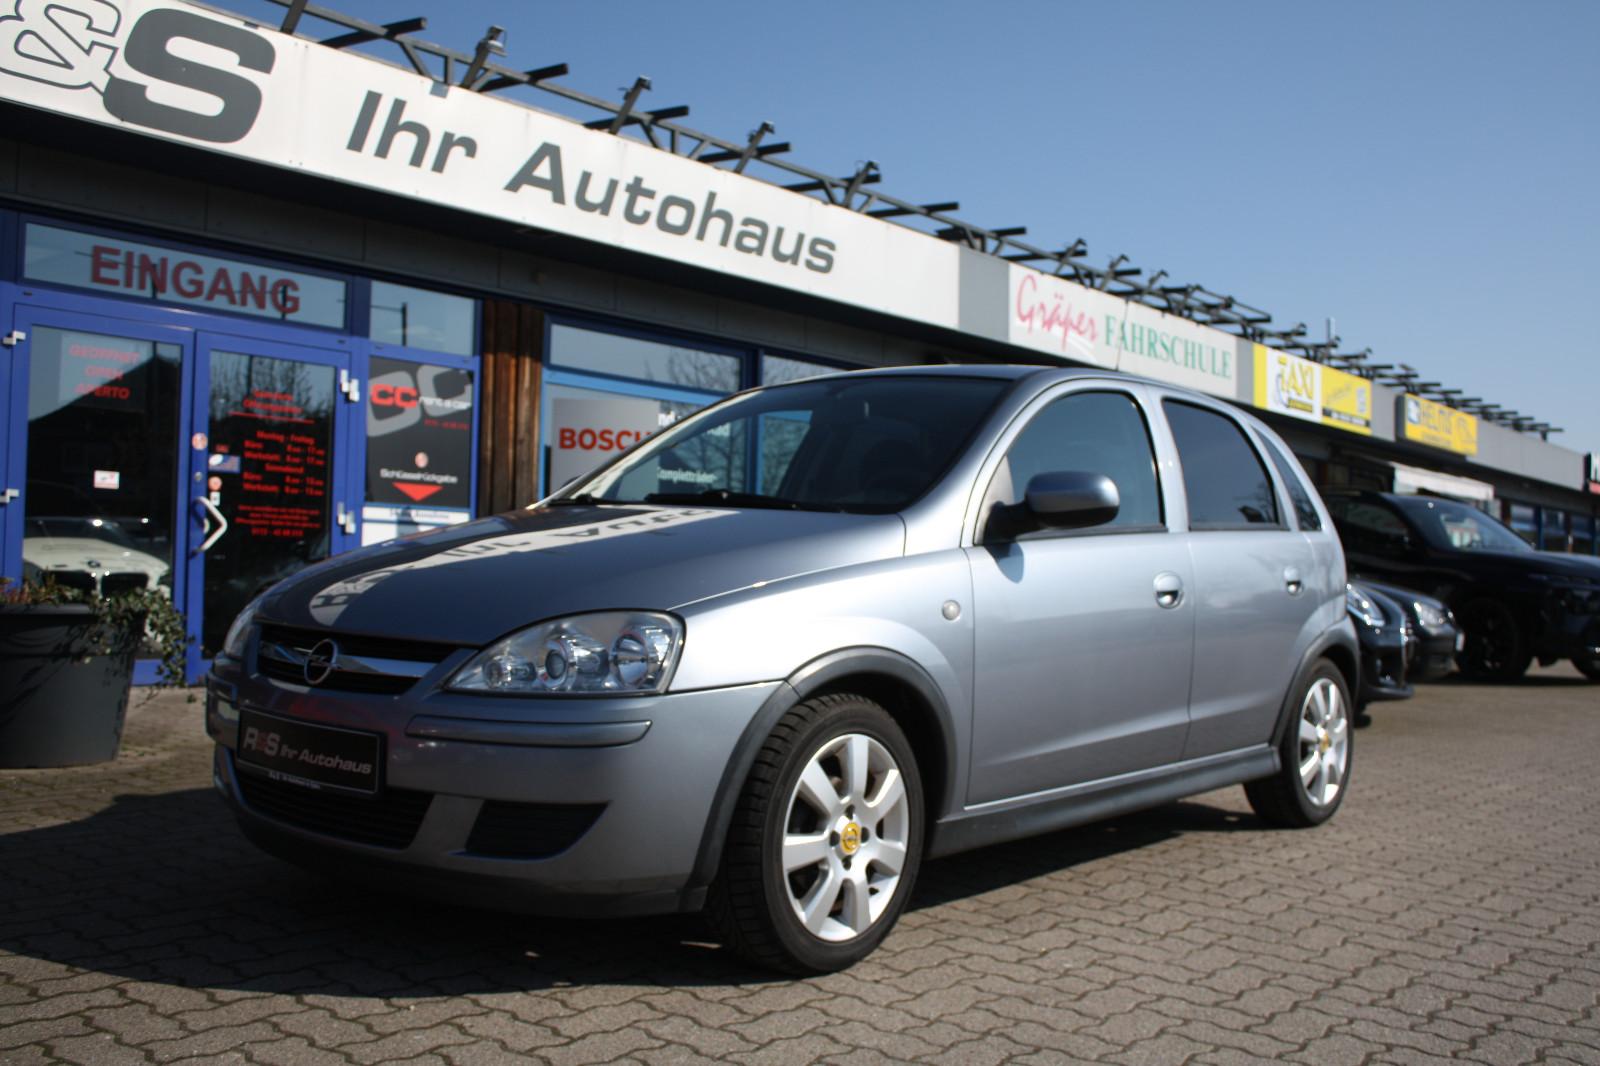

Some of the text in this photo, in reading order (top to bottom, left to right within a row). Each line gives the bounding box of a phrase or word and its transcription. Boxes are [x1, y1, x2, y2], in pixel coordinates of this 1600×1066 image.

[346, 90, 478, 174] Ihr
[503, 141, 837, 274] Autohaus
[90, 244, 301, 315] EINGANG
[1016, 274, 1233, 379] Gräper FAHRSCHULE
[559, 428, 651, 451] BOSC
[299, 749, 373, 775] Autohaus
